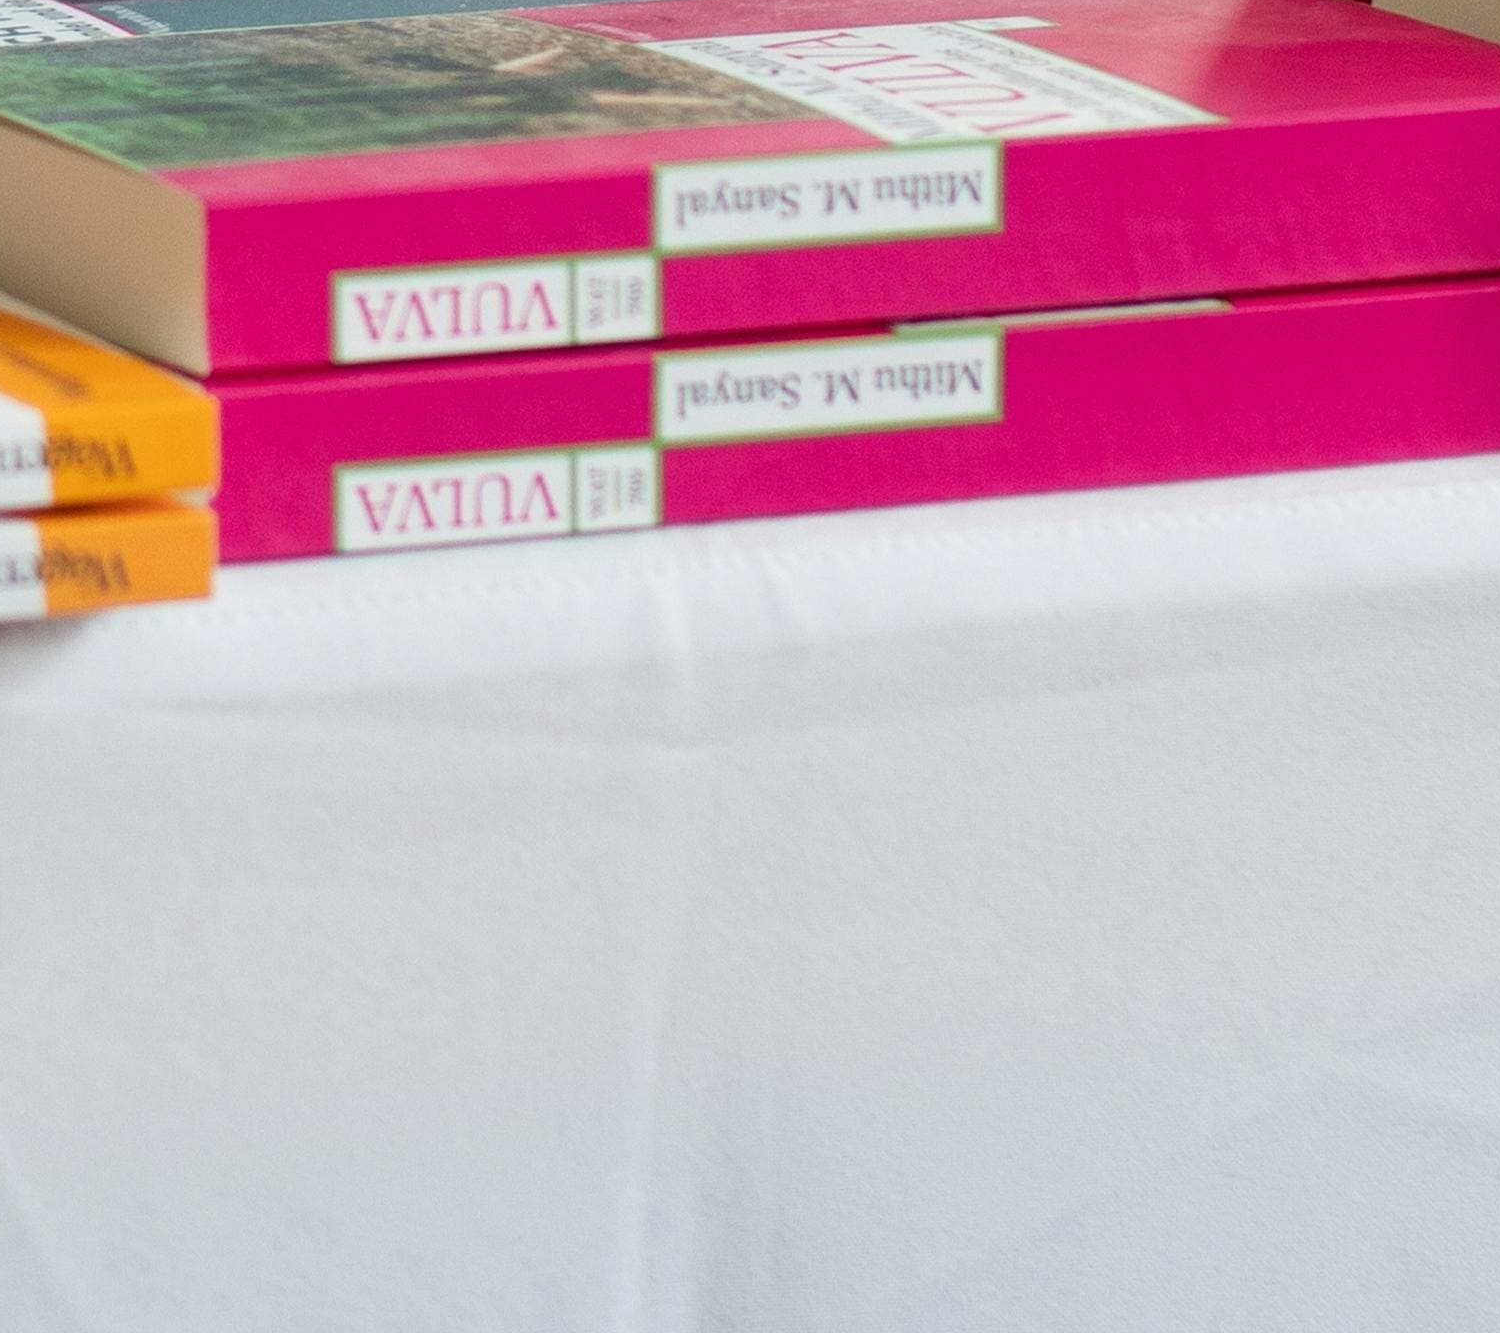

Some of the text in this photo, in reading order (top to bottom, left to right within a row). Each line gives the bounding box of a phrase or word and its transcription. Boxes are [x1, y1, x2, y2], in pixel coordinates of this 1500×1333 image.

[760, 32, 1075, 133] VULVA
[674, 168, 985, 229] Mithu M. Sanyal
[354, 280, 560, 344] VULVA
[675, 359, 986, 421] Mithu M. Sanyal
[356, 471, 560, 537] VULVA
